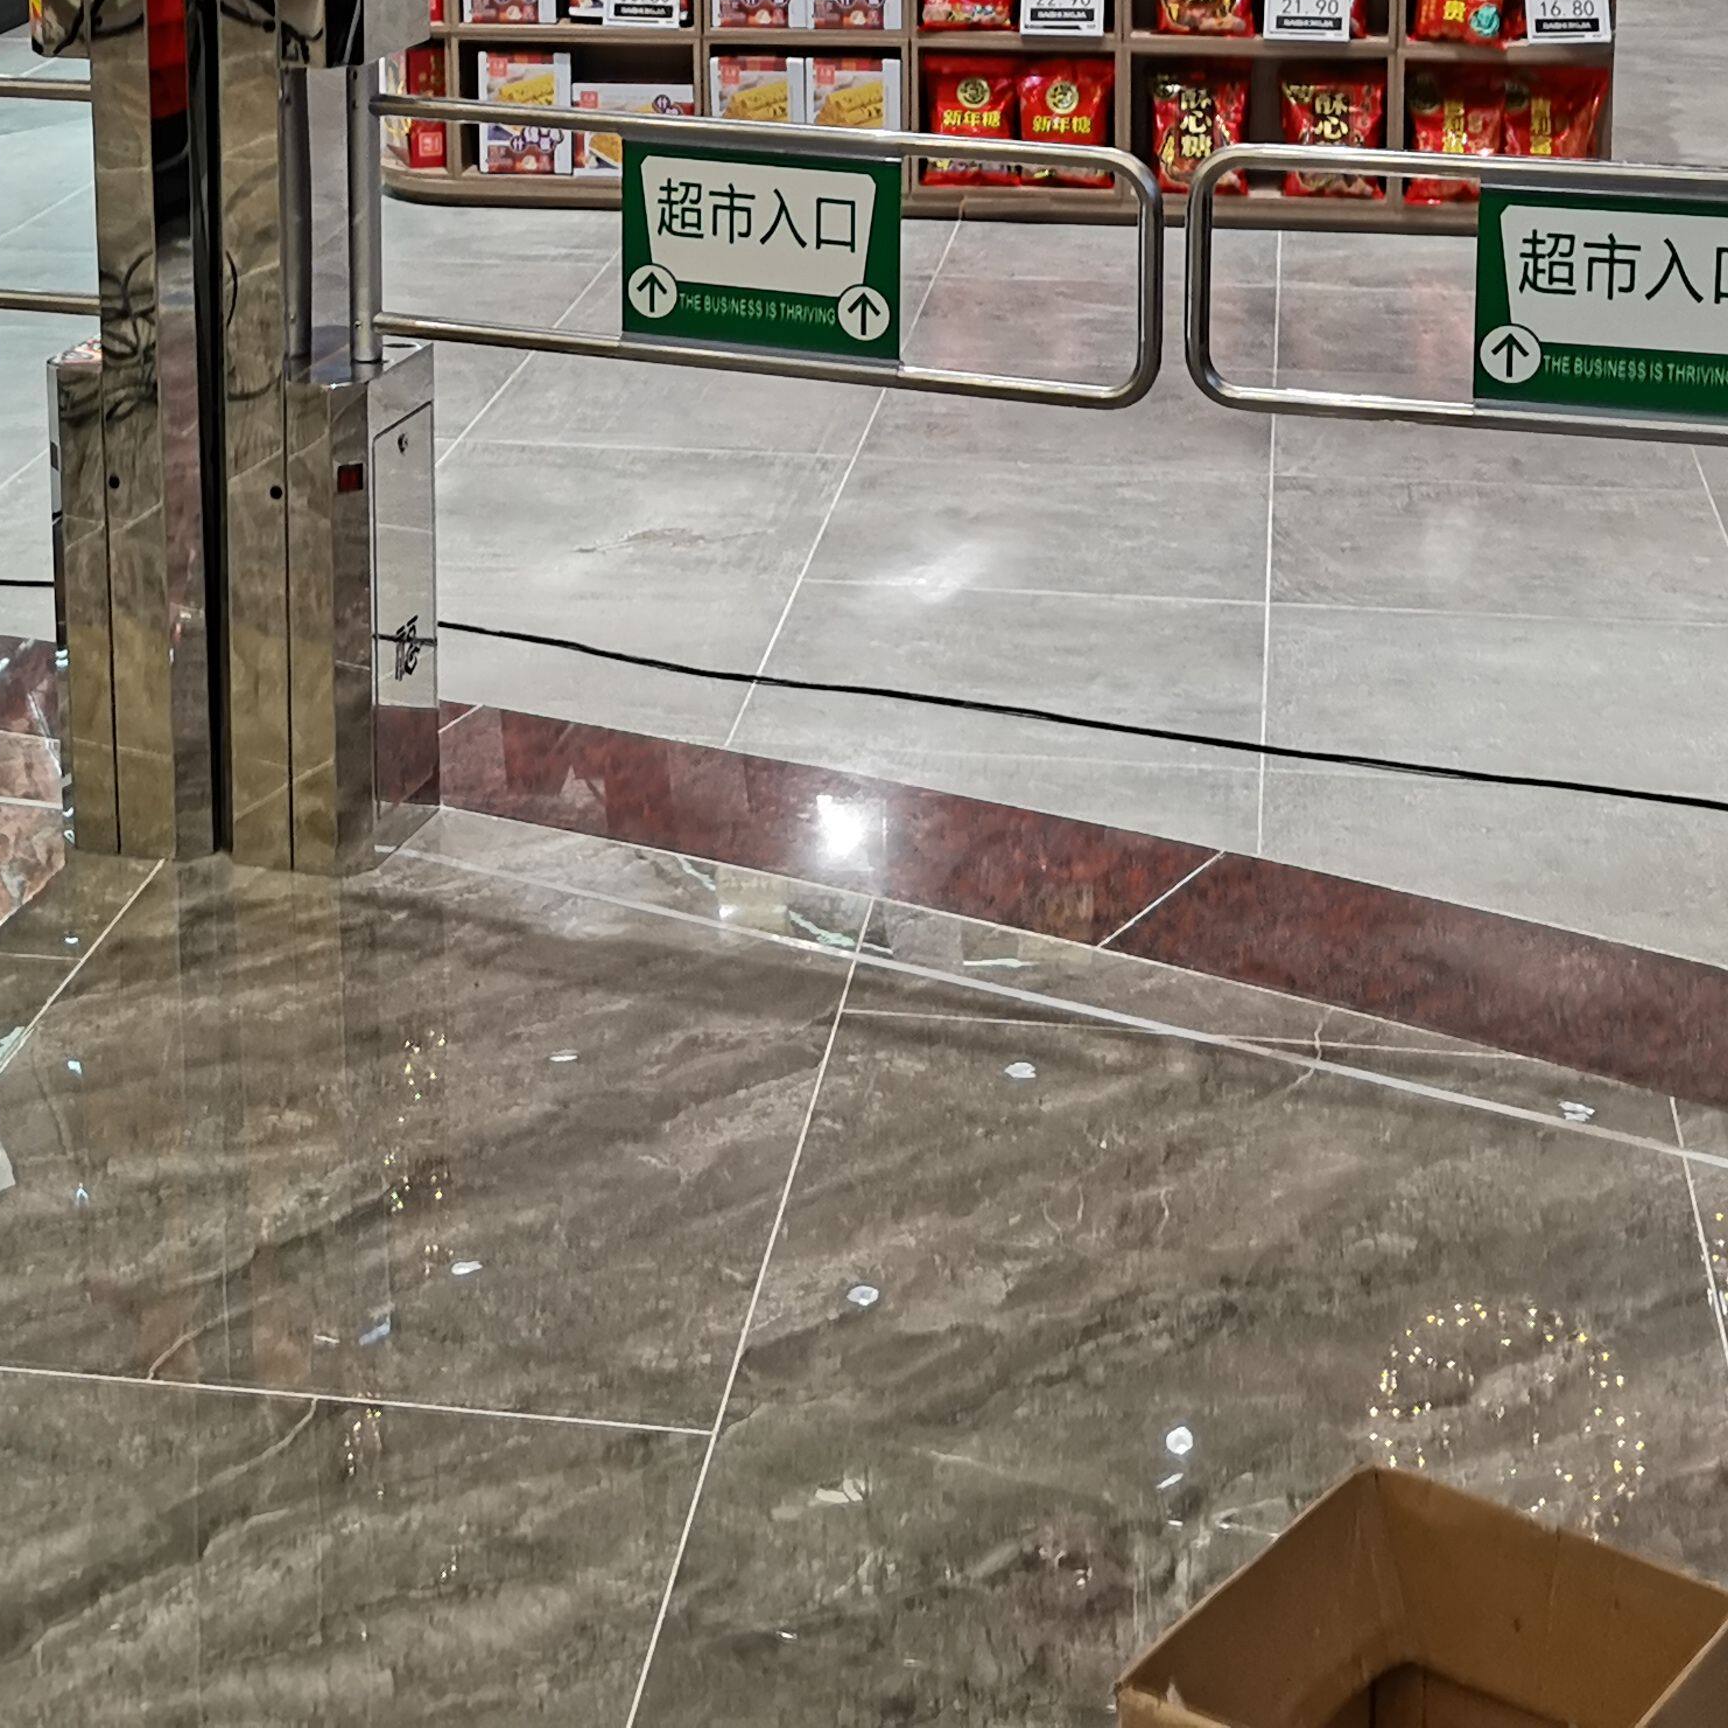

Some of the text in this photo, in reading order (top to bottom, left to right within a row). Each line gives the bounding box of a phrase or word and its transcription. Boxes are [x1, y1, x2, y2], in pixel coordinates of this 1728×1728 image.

[1539, 0, 1595, 17] 16.80
[943, 109, 1001, 127] 新年糖
[1032, 115, 1092, 134] 新年糖
[1180, 87, 1212, 158] 酥心糖
[1313, 92, 1350, 146] 酥心
[656, 177, 857, 254] 超市入口
[1518, 228, 1728, 305] 超市入
[679, 293, 838, 327] THE BUSINESS IS THRIVING
[1543, 355, 1570, 374] THE
[1574, 357, 1646, 382] BUSINESS
[1649, 363, 1663, 383] IS
